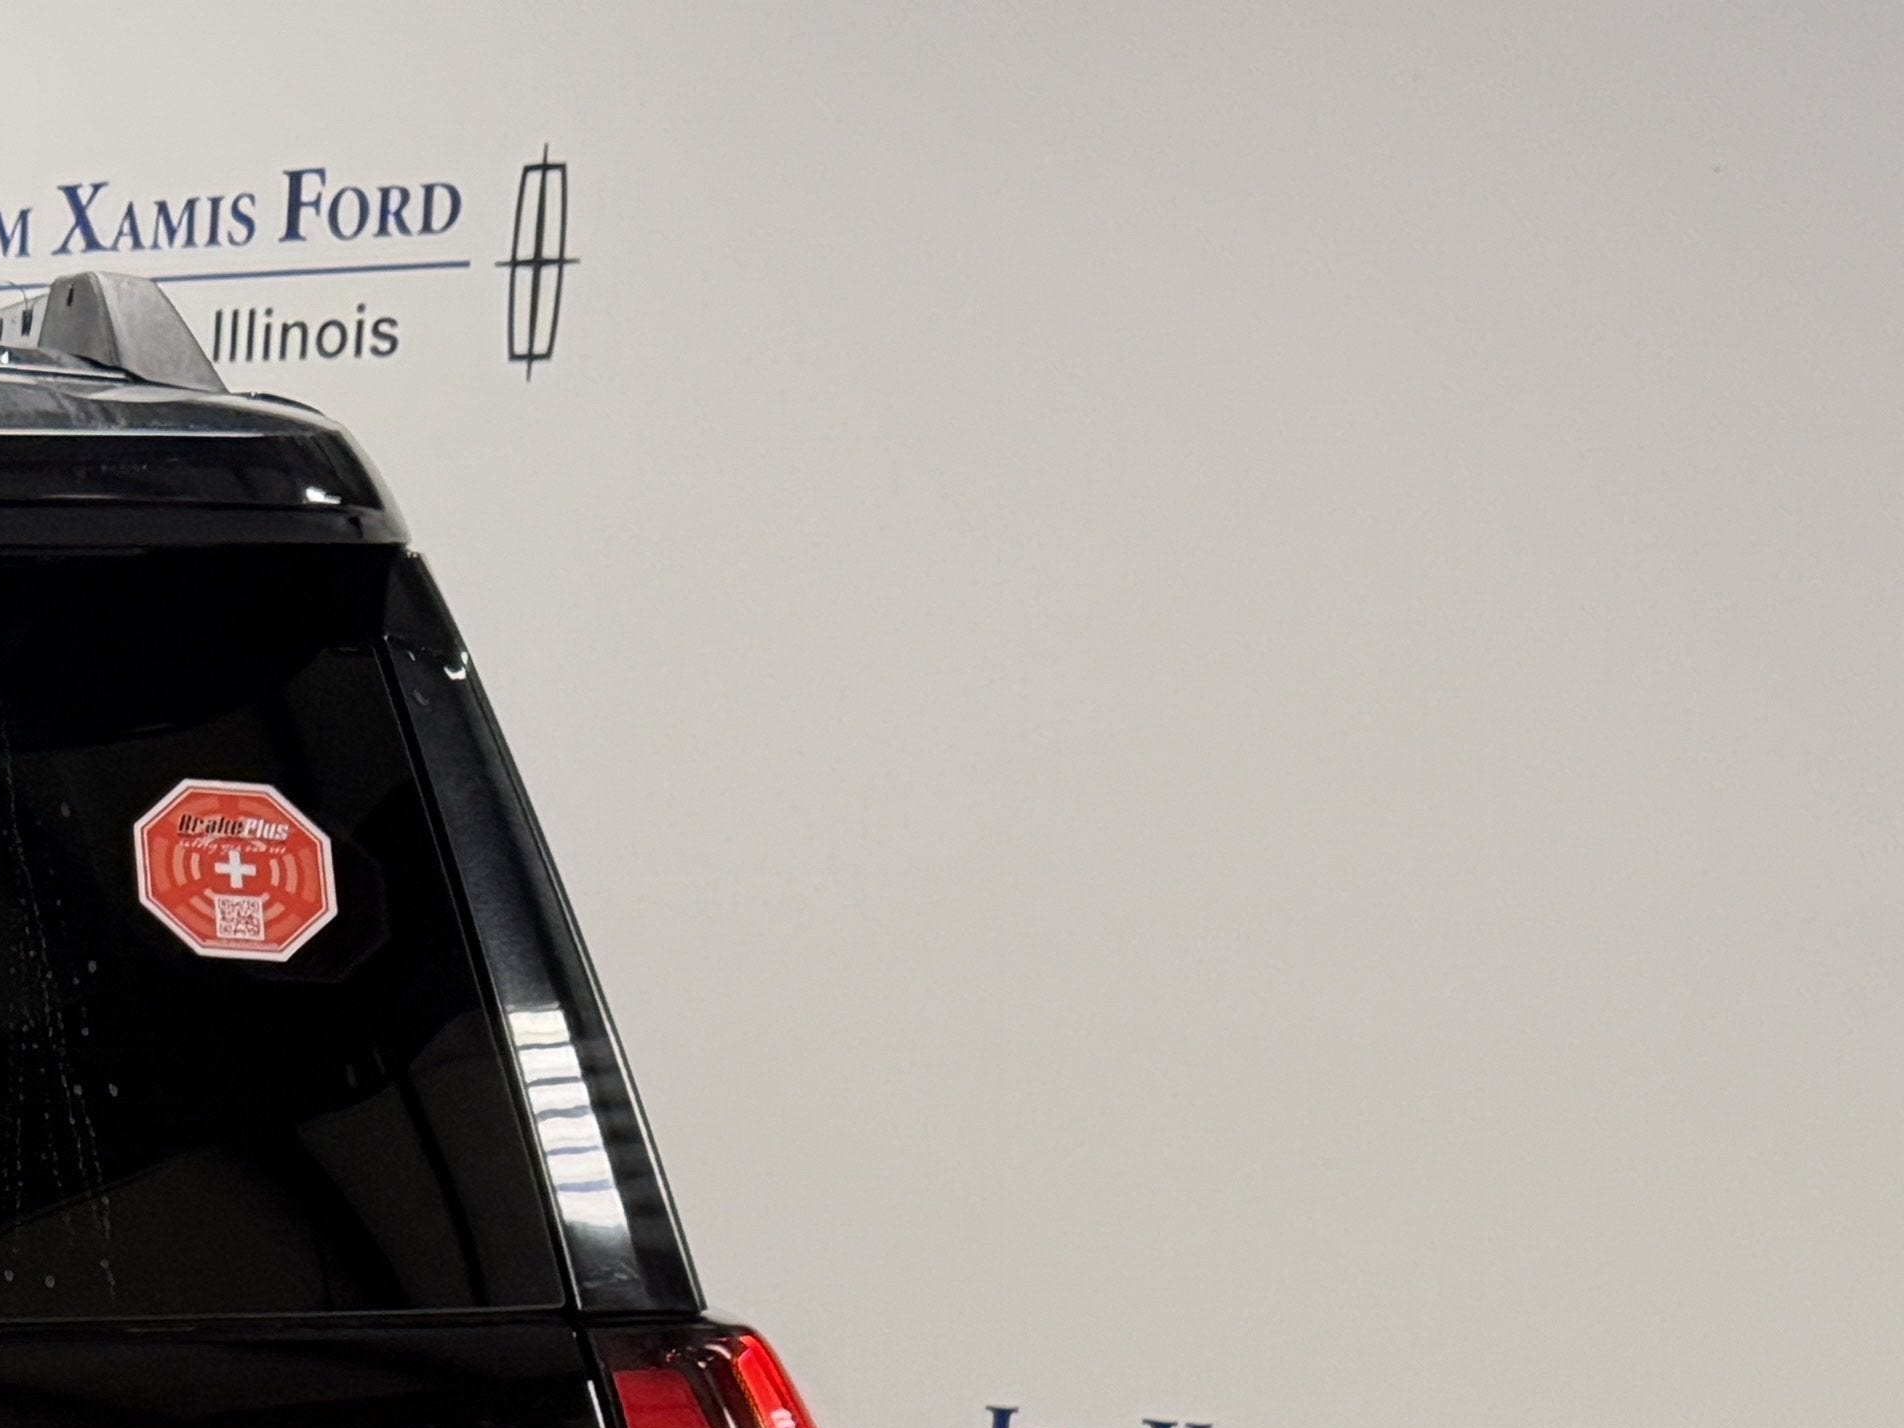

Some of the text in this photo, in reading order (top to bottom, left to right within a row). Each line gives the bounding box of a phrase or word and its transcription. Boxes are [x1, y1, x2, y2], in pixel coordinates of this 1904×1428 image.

[51, 180, 256, 257] XAMIS
[278, 167, 462, 242] FORD
[212, 303, 400, 365] Illinois
